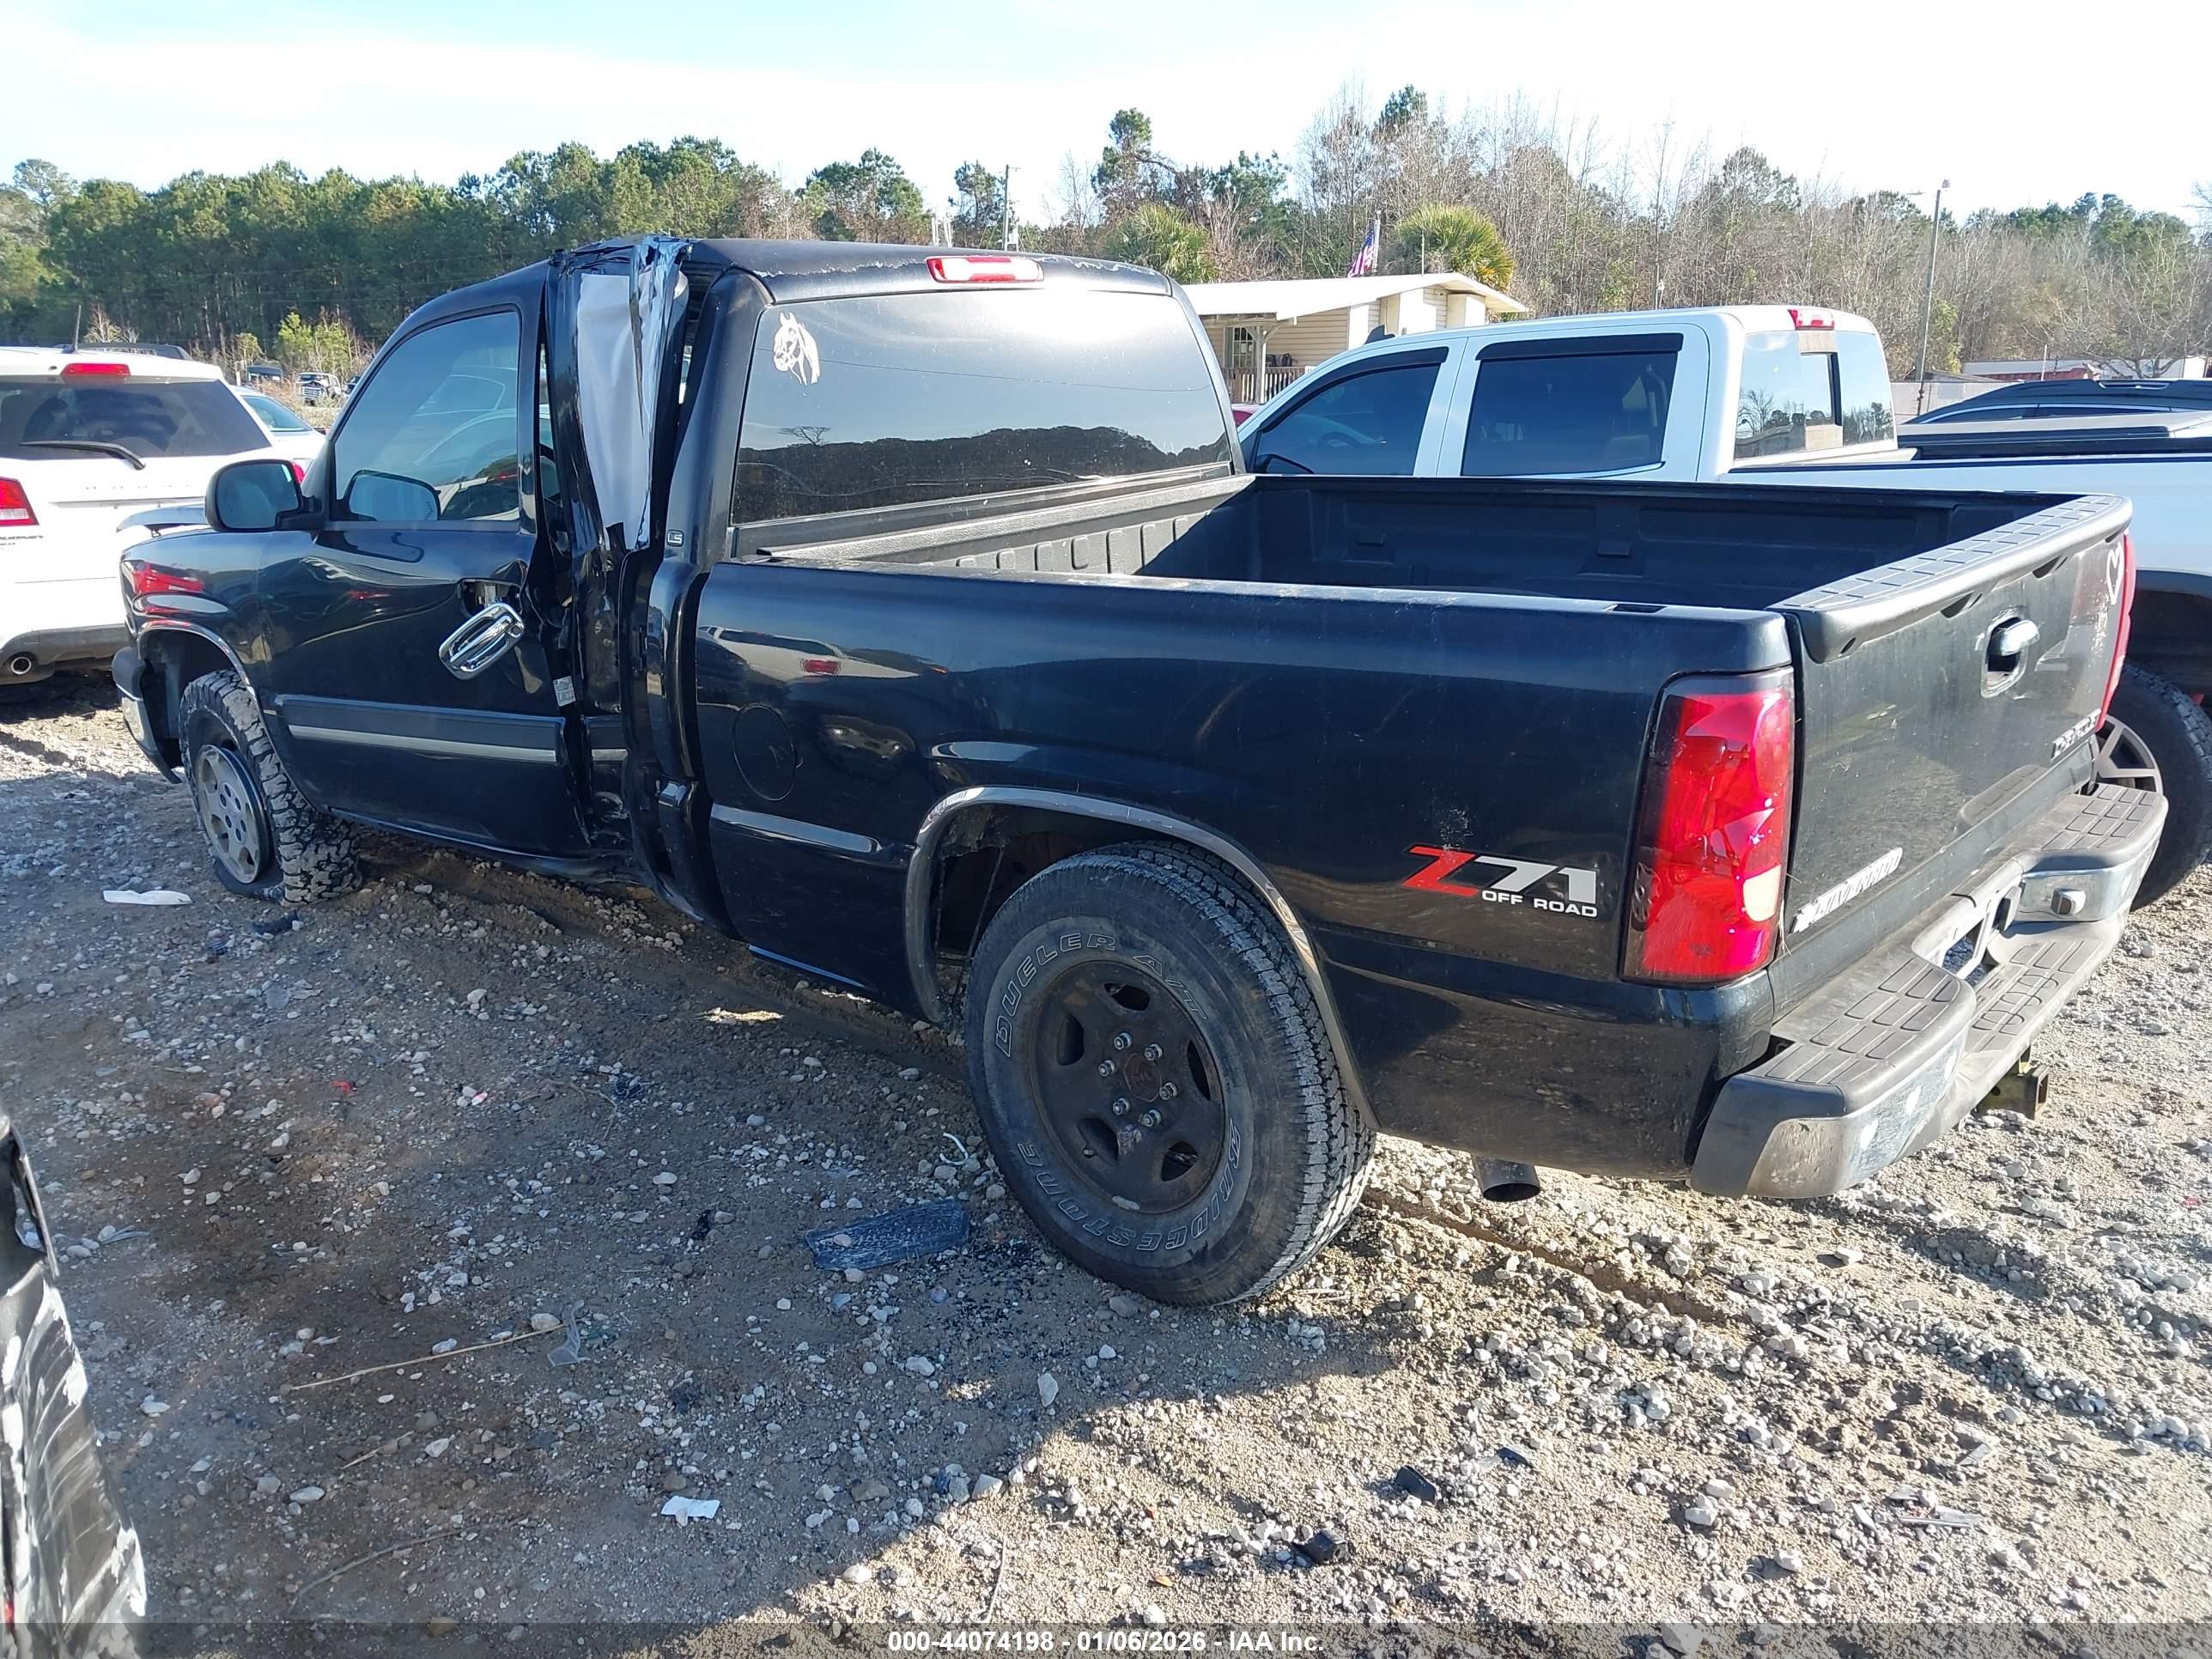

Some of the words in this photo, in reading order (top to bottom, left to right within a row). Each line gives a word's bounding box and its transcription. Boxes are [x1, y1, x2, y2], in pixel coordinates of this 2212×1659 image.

[668, 532, 683, 544] LS
[1401, 845, 1597, 904] Z71
[1481, 890, 1523, 905] OFF
[1533, 897, 1598, 918] ROAD
[995, 933, 1116, 1059] DUELER
[1133, 954, 1207, 1020] A/T
[1017, 1117, 1242, 1251] BRIDGESTONE
